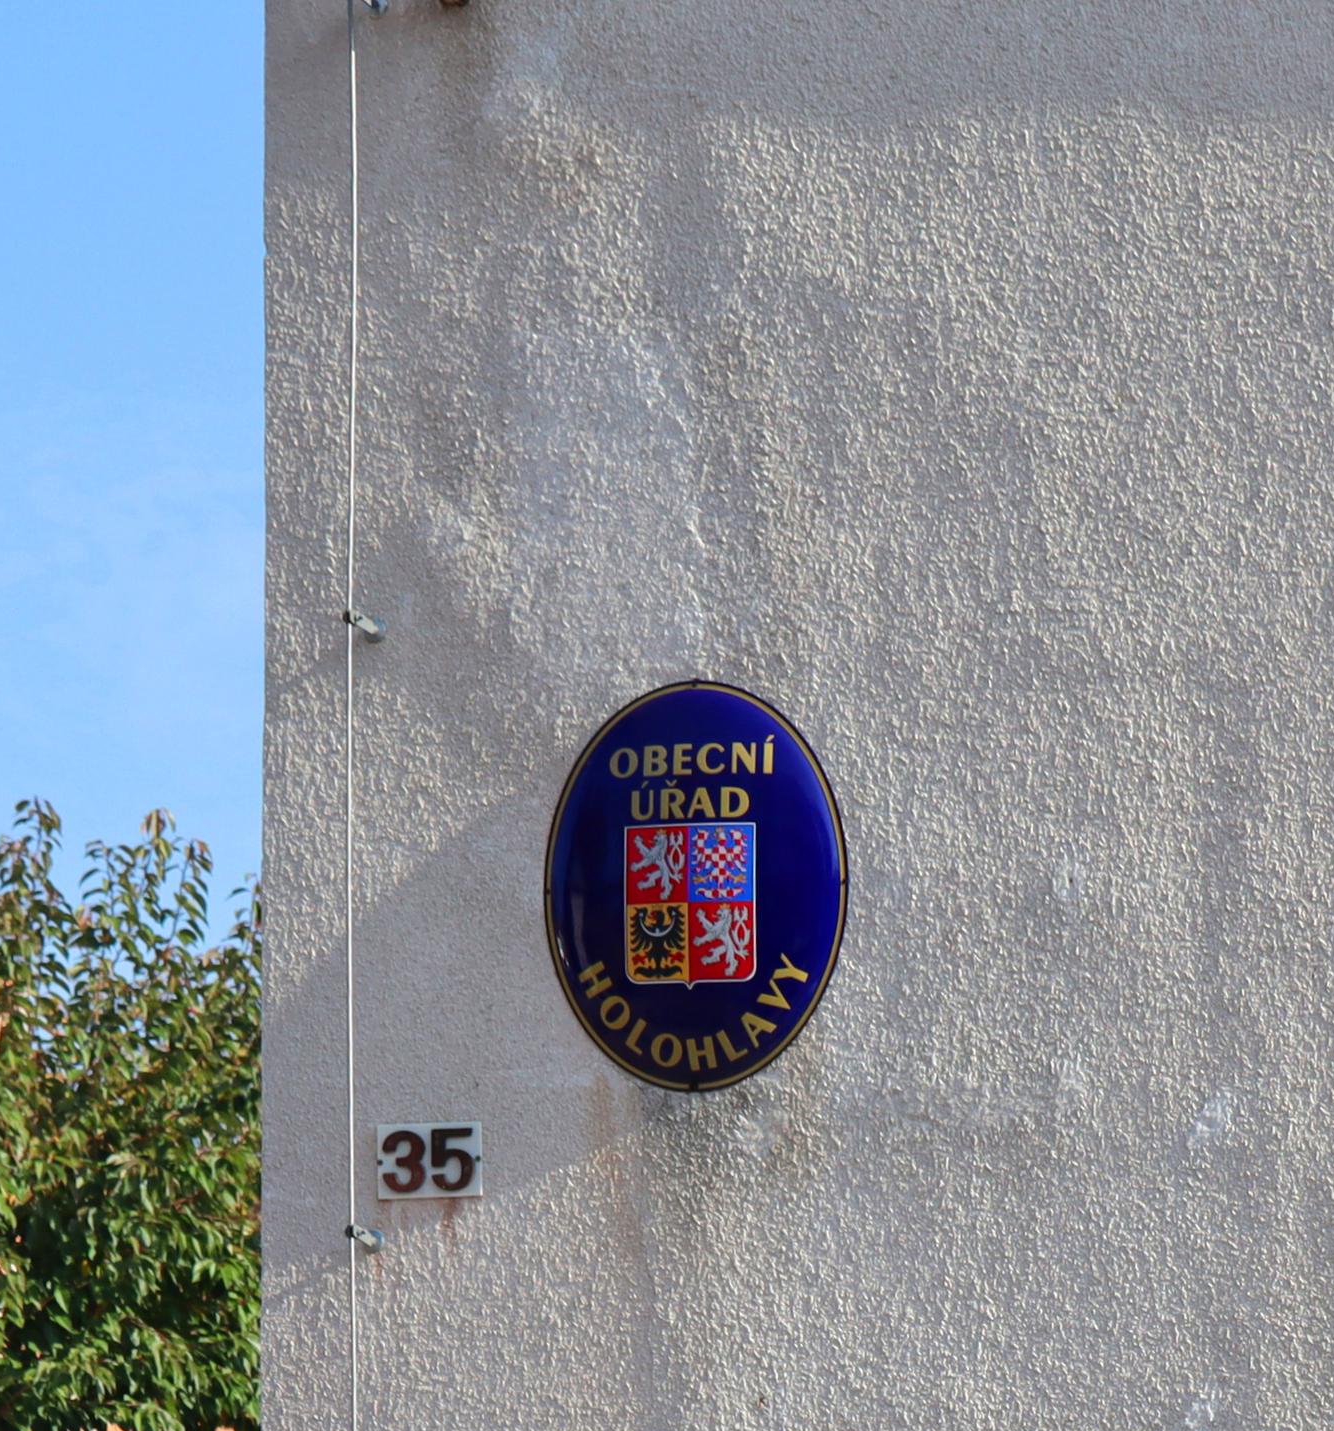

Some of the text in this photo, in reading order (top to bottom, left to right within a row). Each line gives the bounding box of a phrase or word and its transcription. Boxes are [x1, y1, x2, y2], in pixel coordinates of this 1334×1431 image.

[609, 735, 775, 779] OBECNÍ
[631, 780, 750, 821] ÚŘAD
[579, 953, 809, 1072] HOLOHLAVY
[382, 1128, 475, 1193] 35
